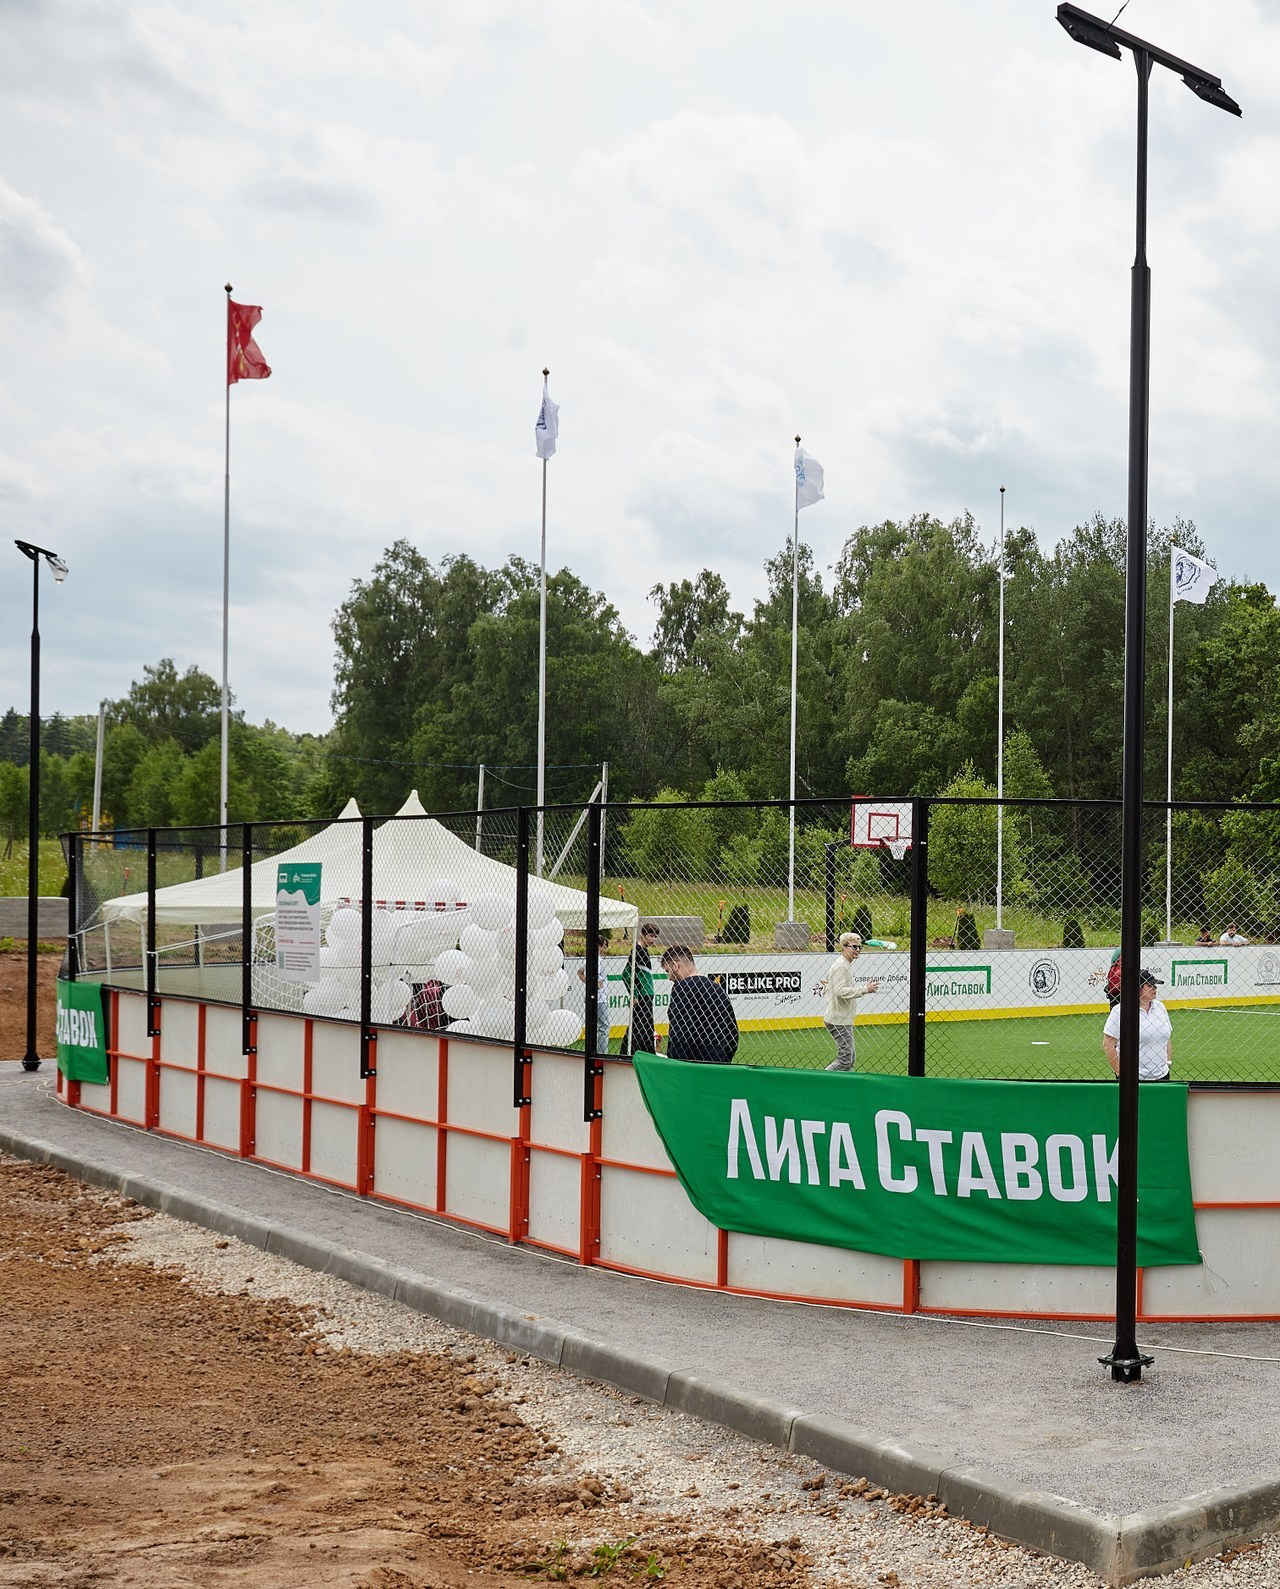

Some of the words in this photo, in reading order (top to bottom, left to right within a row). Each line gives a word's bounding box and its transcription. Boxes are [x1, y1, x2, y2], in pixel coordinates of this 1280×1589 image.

[729, 978, 745, 990] BE
[747, 977, 773, 989] LIKE
[776, 976, 800, 989] PRO
[853, 975, 886, 983] озвездие
